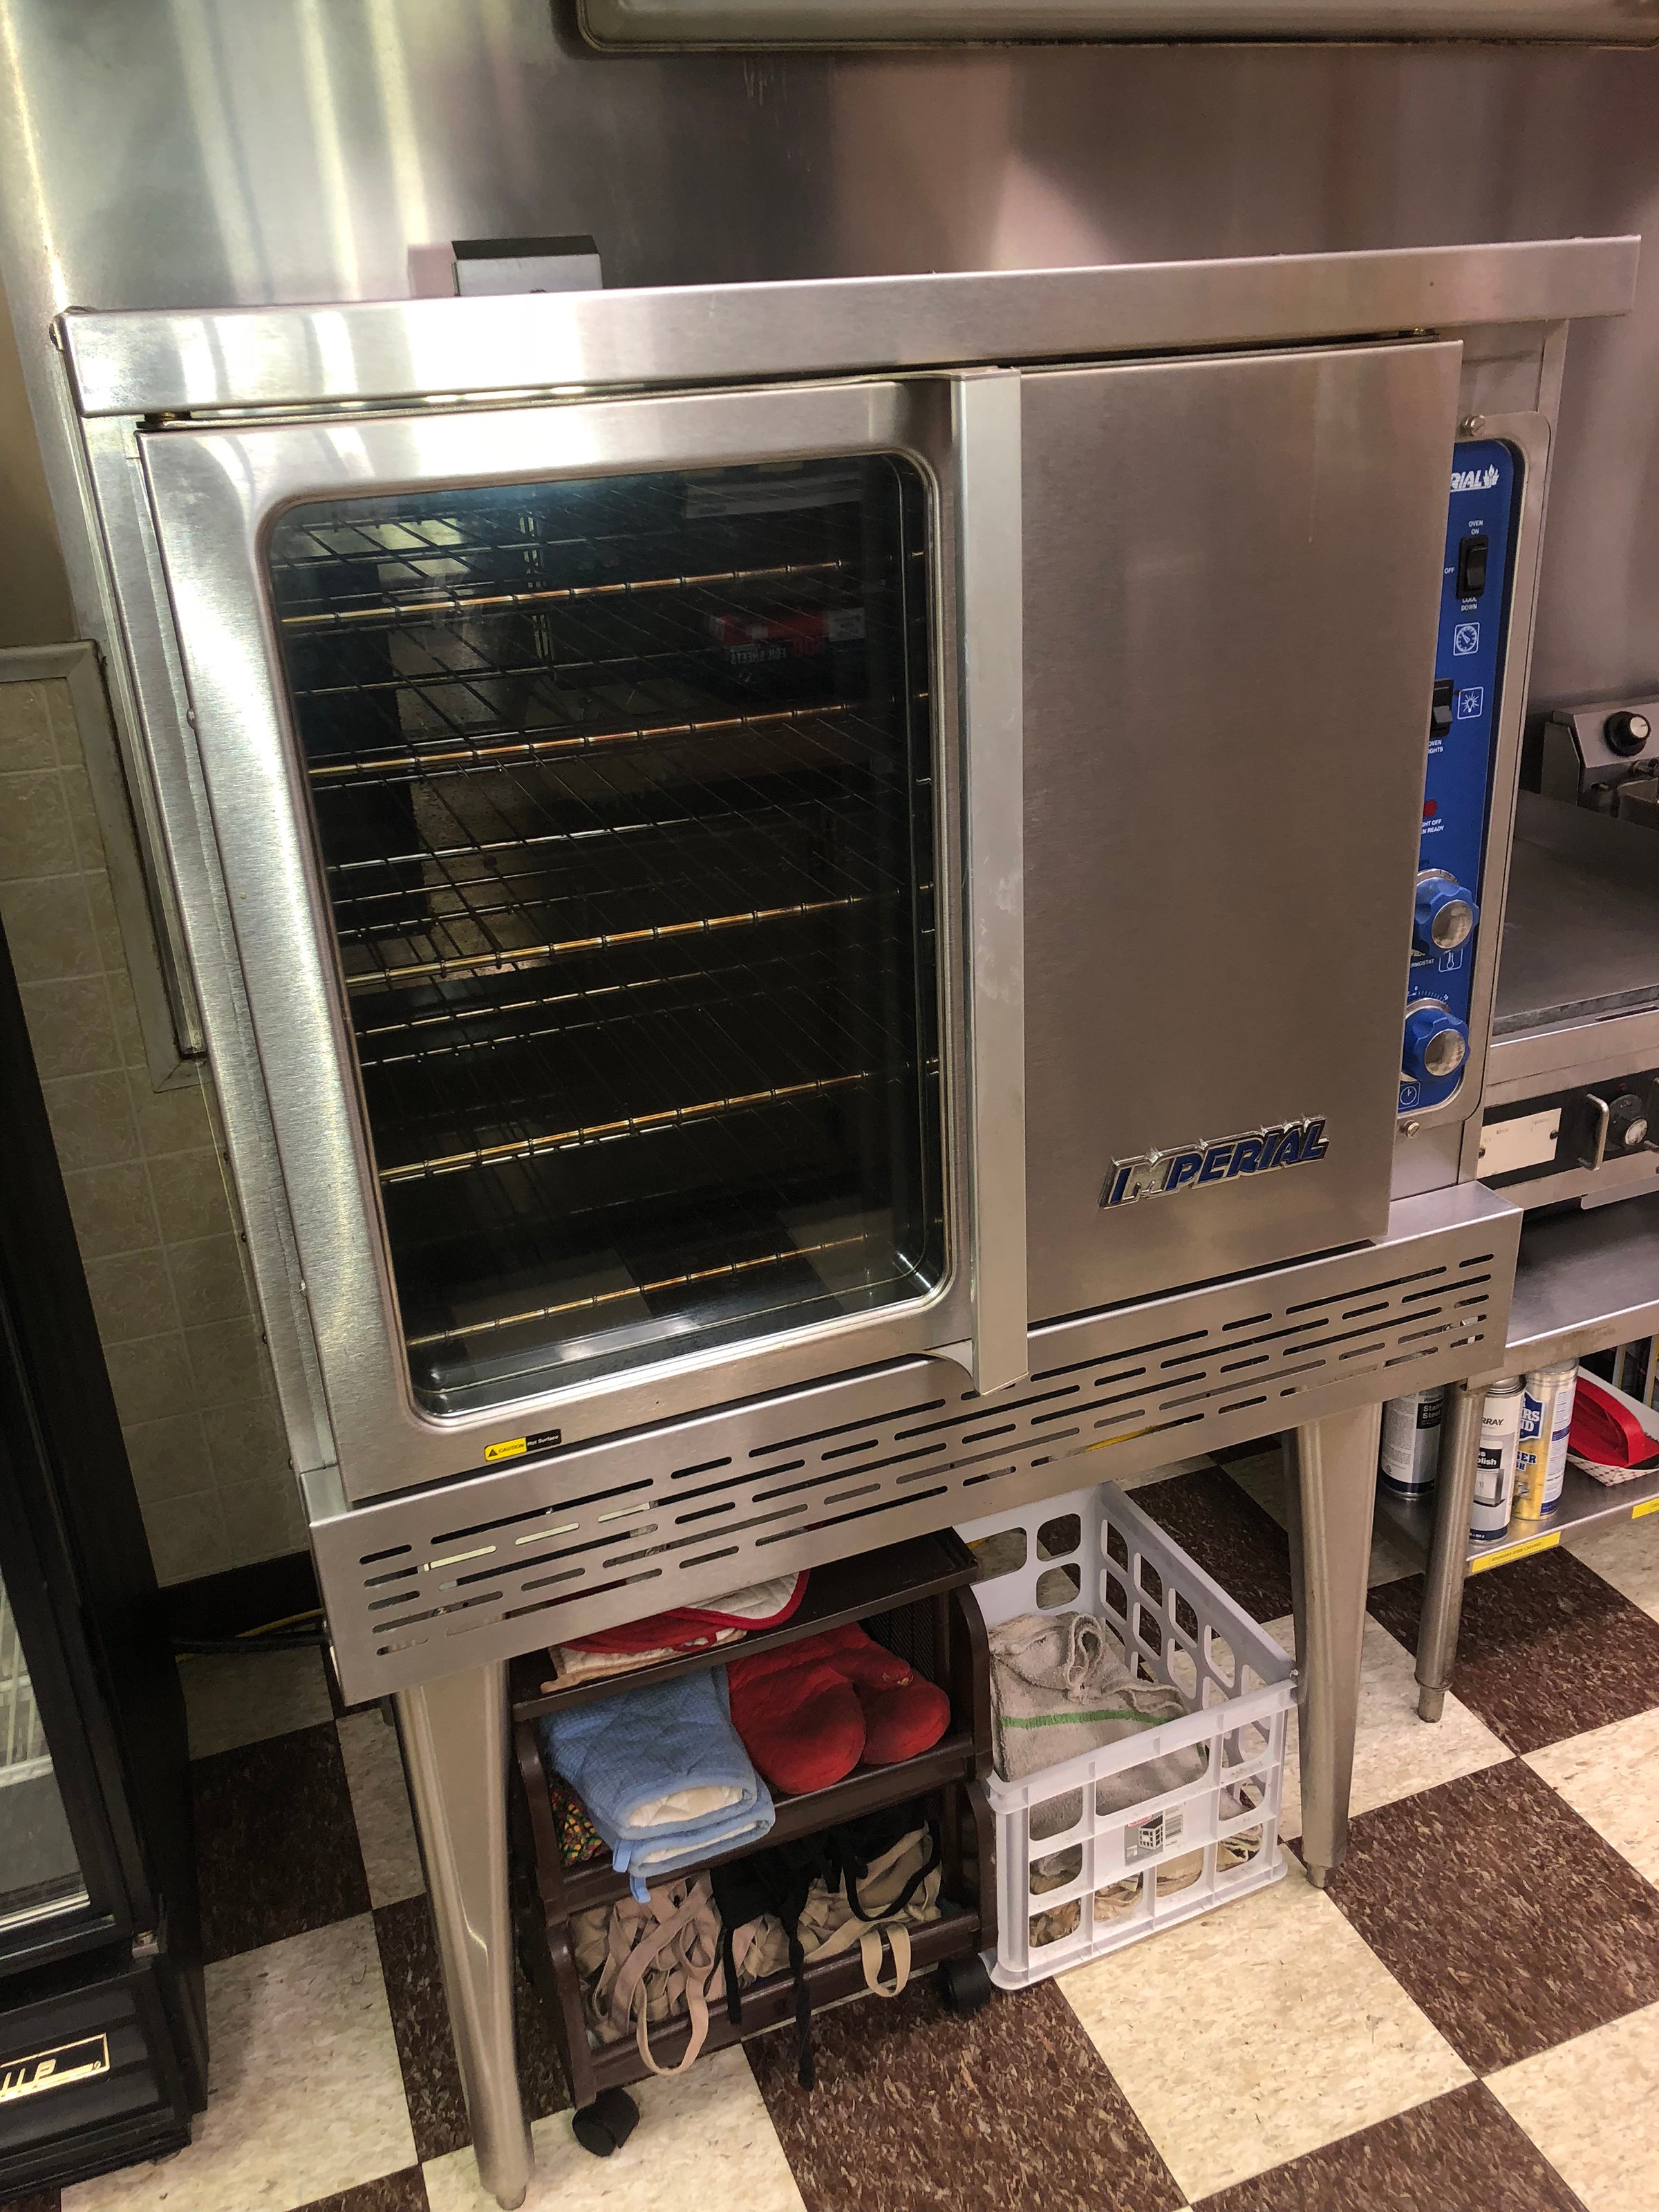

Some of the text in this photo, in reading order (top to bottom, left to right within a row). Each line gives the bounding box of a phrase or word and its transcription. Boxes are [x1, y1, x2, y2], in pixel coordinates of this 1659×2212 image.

[1461, 603, 1478, 612] DOWN
[1106, 1118, 1329, 1207] IMPERIAL
[1423, 1409, 1441, 1419] Steel
[498, 1443, 525, 1453] CAUTION
[538, 1434, 559, 1443] Surface
